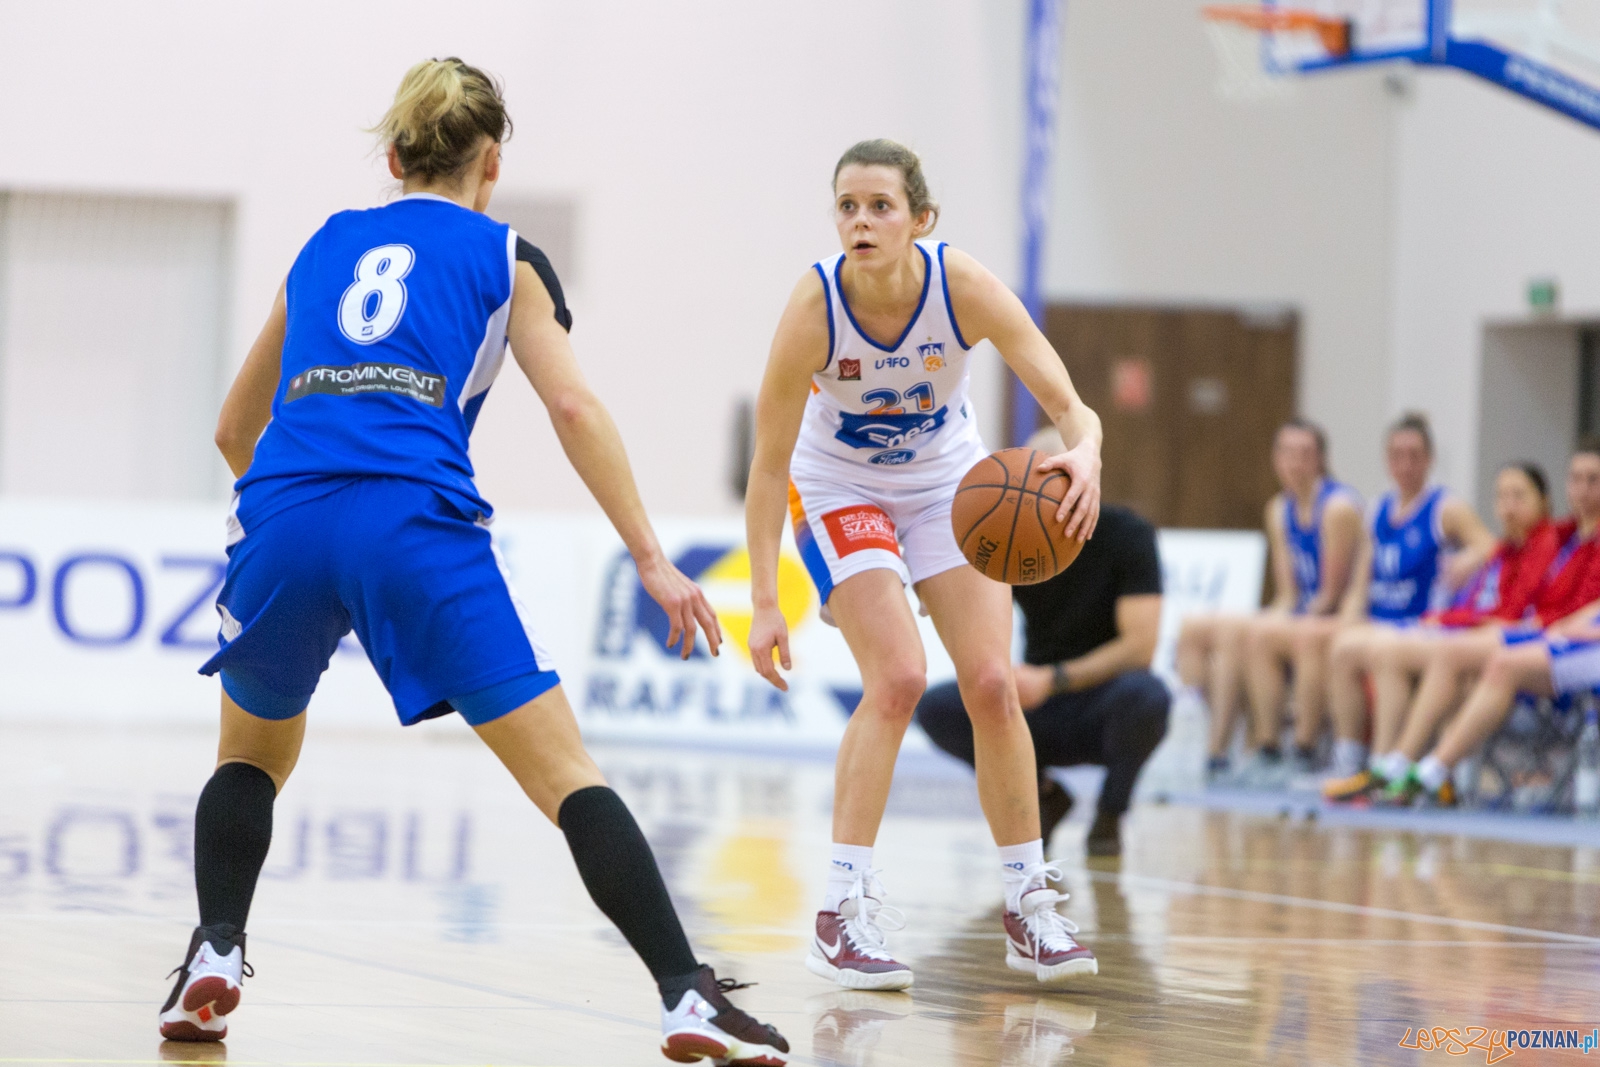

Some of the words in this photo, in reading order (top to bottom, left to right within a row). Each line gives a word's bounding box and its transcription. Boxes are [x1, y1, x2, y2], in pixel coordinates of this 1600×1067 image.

[337, 243, 416, 346] 8
[306, 366, 441, 391] PROMINENT
[355, 383, 388, 391] ORIGINAL
[861, 381, 935, 417] 21
[876, 451, 911, 465] Ford
[1022, 557, 1037, 582] 250
